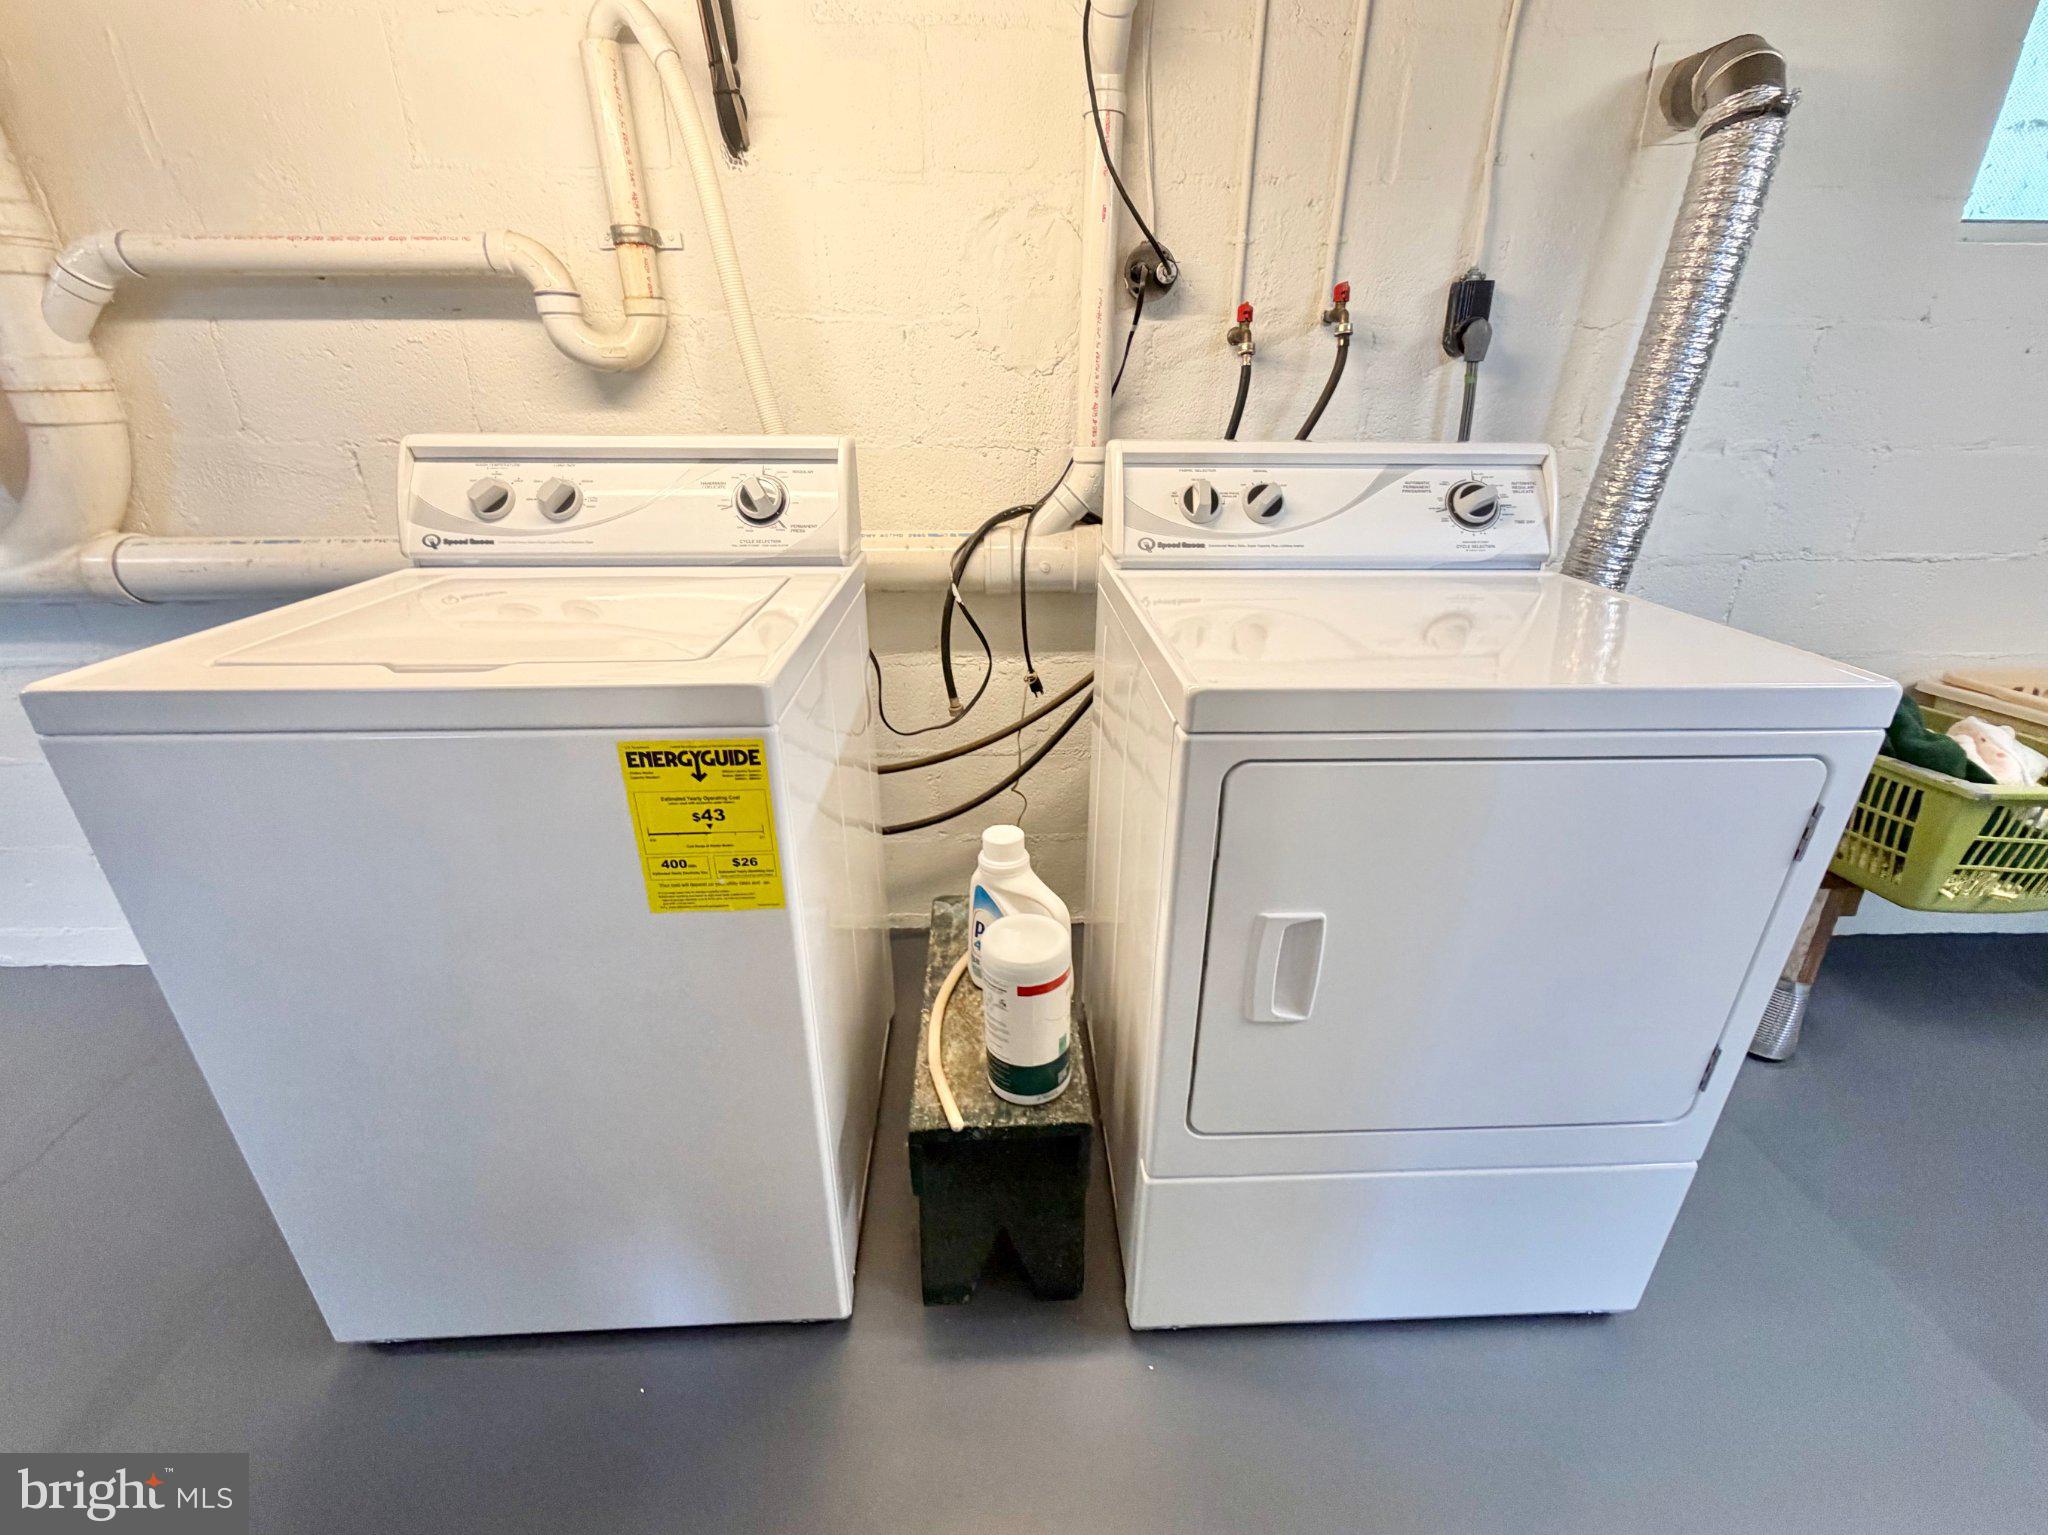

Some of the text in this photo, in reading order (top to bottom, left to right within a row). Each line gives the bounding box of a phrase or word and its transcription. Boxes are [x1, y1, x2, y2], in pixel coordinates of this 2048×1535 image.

[443, 538, 468, 546] Speed
[1157, 541, 1181, 550] Speed
[625, 749, 762, 770] ENERGYGUIDE
[691, 808, 726, 823] $43
[661, 859, 688, 869] 400
[732, 857, 758, 867] $26
